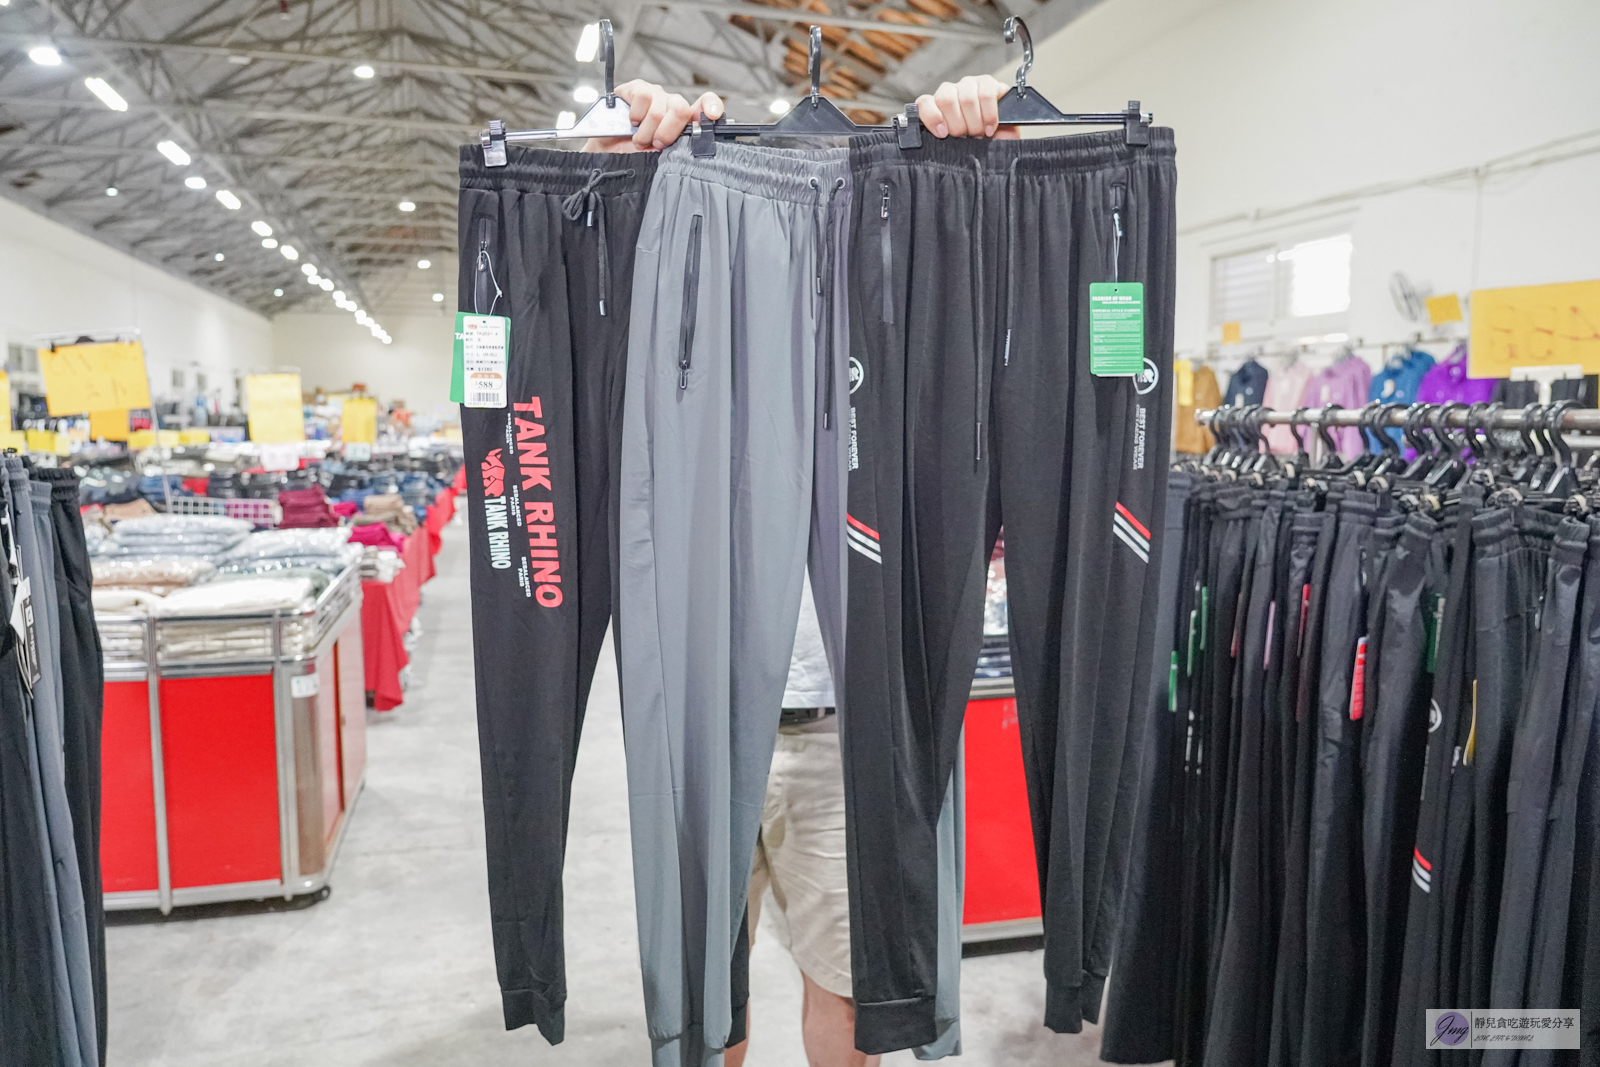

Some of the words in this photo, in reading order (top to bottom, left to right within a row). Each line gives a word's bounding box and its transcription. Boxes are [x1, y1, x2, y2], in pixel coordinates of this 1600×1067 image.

[454, 332, 464, 340] TA
[1139, 407, 1147, 430] BEST
[513, 396, 552, 491] TANK
[851, 430, 859, 469] FOREVER
[1137, 430, 1146, 469] FOREVER
[484, 495, 509, 529] TANK
[488, 531, 512, 570] RHINO
[524, 501, 564, 608] RHINO
